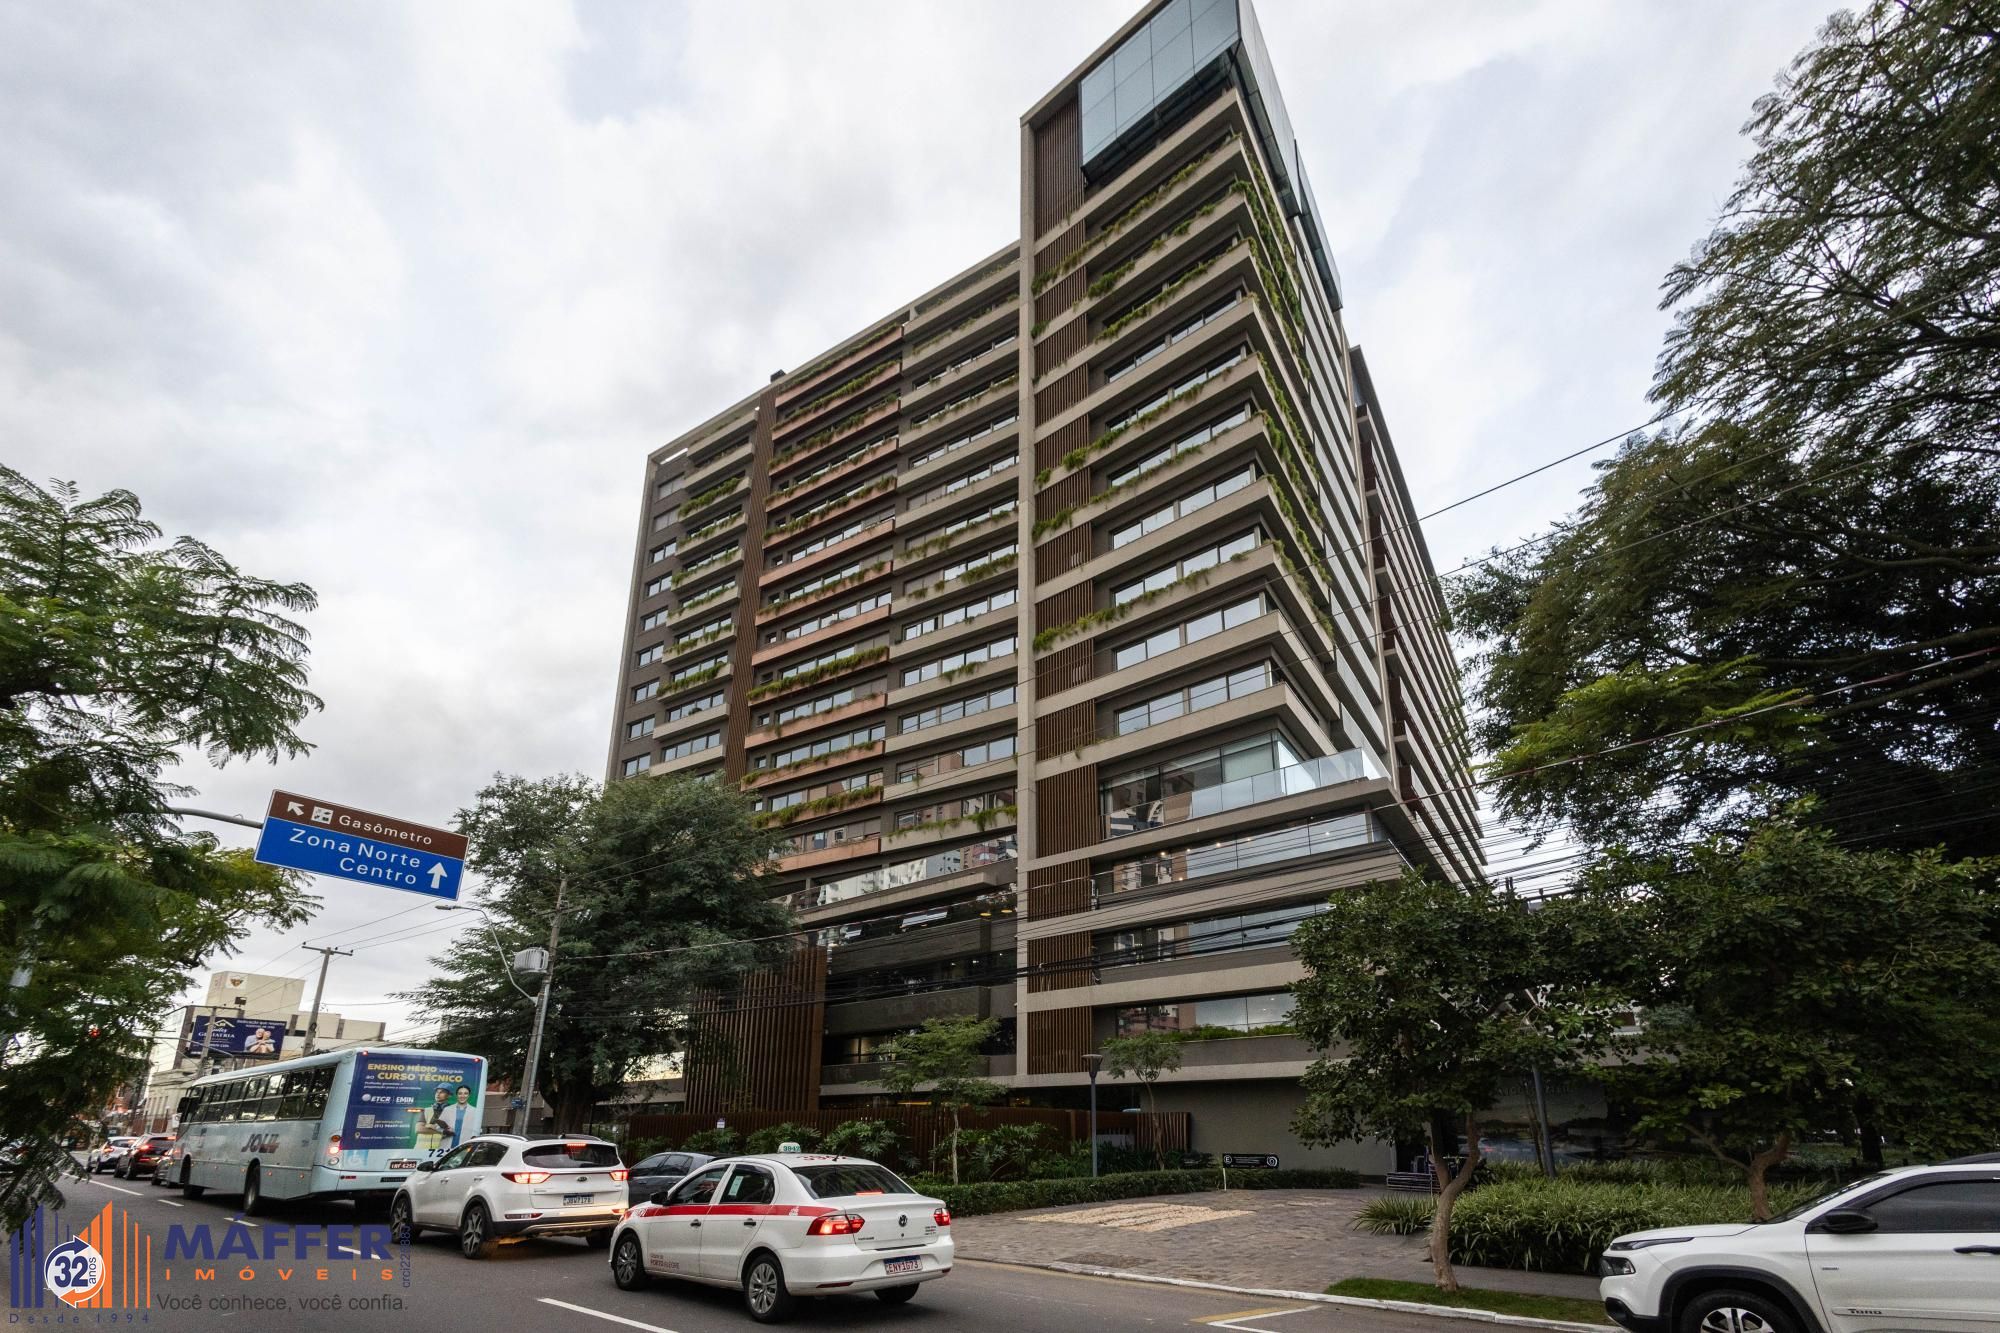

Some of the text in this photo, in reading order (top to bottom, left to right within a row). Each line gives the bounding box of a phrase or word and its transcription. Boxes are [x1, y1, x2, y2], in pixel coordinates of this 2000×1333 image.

[338, 815, 432, 845] Gasômetro
[289, 828, 421, 868] Zona Norte
[339, 858, 417, 885] Centro
[367, 1063, 405, 1072] ENSINO
[407, 1064, 438, 1073] MÉDIO
[377, 1072, 416, 1081] CURSO
[419, 1073, 463, 1083] TÉCNICO
